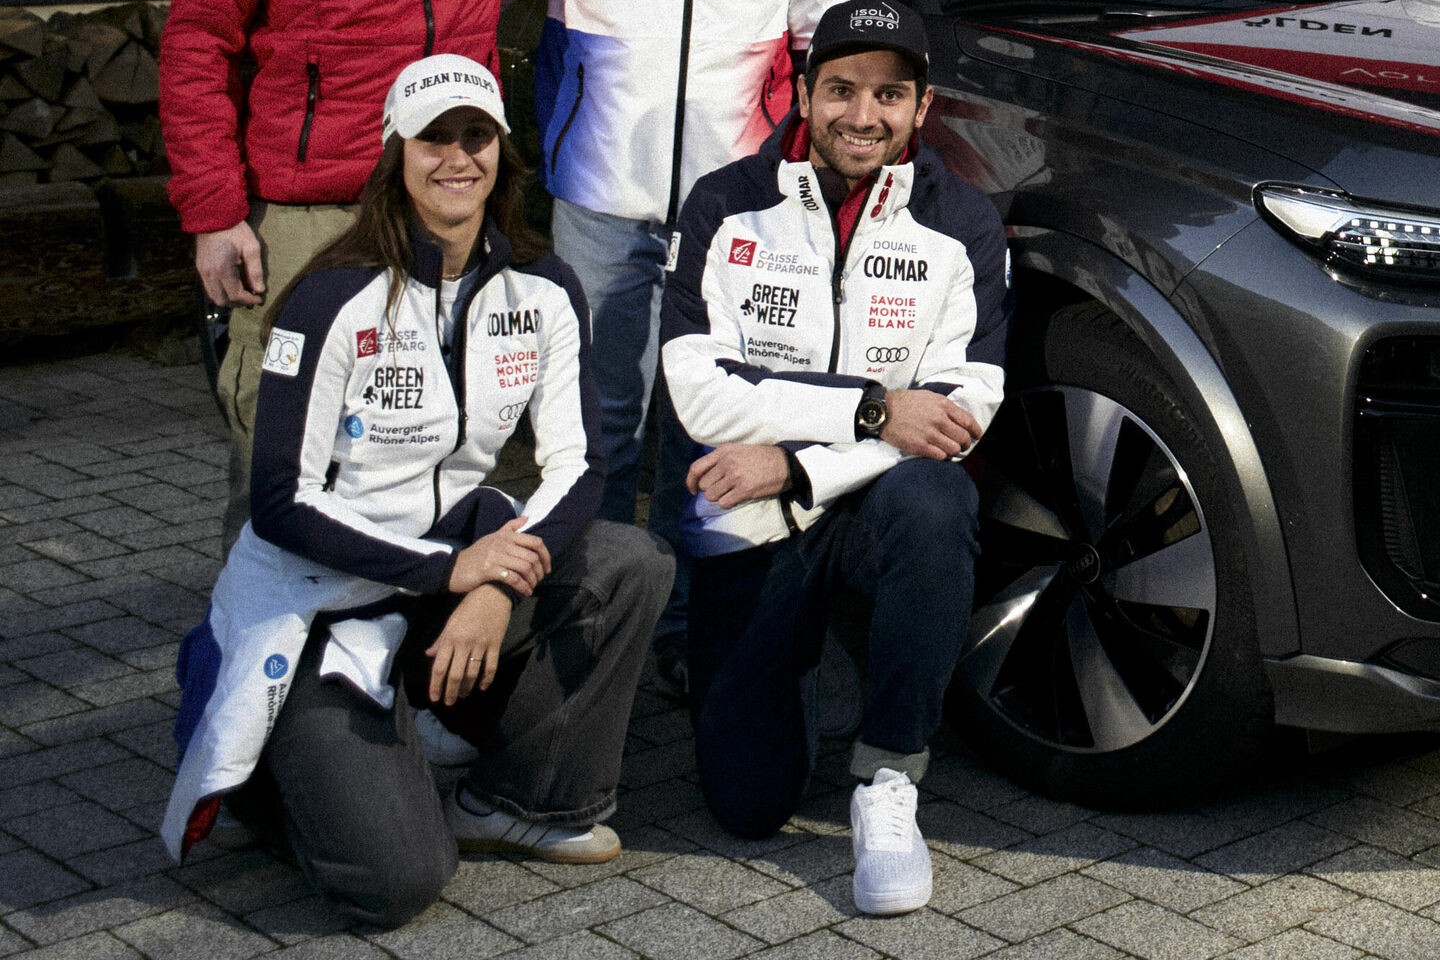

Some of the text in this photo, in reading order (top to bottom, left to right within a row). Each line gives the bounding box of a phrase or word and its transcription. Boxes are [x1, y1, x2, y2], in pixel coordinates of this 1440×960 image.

[855, 8, 896, 20] ISOLA
[854, 19, 895, 30] 2000
[404, 82, 417, 97] ST
[420, 72, 451, 90] JEAN
[798, 175, 819, 211] COLMAR
[873, 240, 918, 254] DOUANE
[758, 250, 799, 264] CAISSE
[756, 259, 819, 276] D'EPARGNE
[864, 255, 928, 282] COLMAR
[752, 283, 799, 309] GREEN
[870, 295, 916, 307] SAVOIE
[755, 305, 797, 328] WEEZ
[868, 318, 916, 329] BLANC
[377, 330, 417, 342] CASSE
[747, 337, 799, 353] Auvergne-
[494, 351, 537, 364] SAVOIE
[747, 348, 811, 365] Rhône-Alpes
[375, 367, 424, 388] GREEN
[499, 374, 537, 388] BLANC
[381, 388, 423, 410] WEEZ
[370, 423, 428, 435] Auvergne-
[369, 432, 440, 445] Rhône-Alpes
